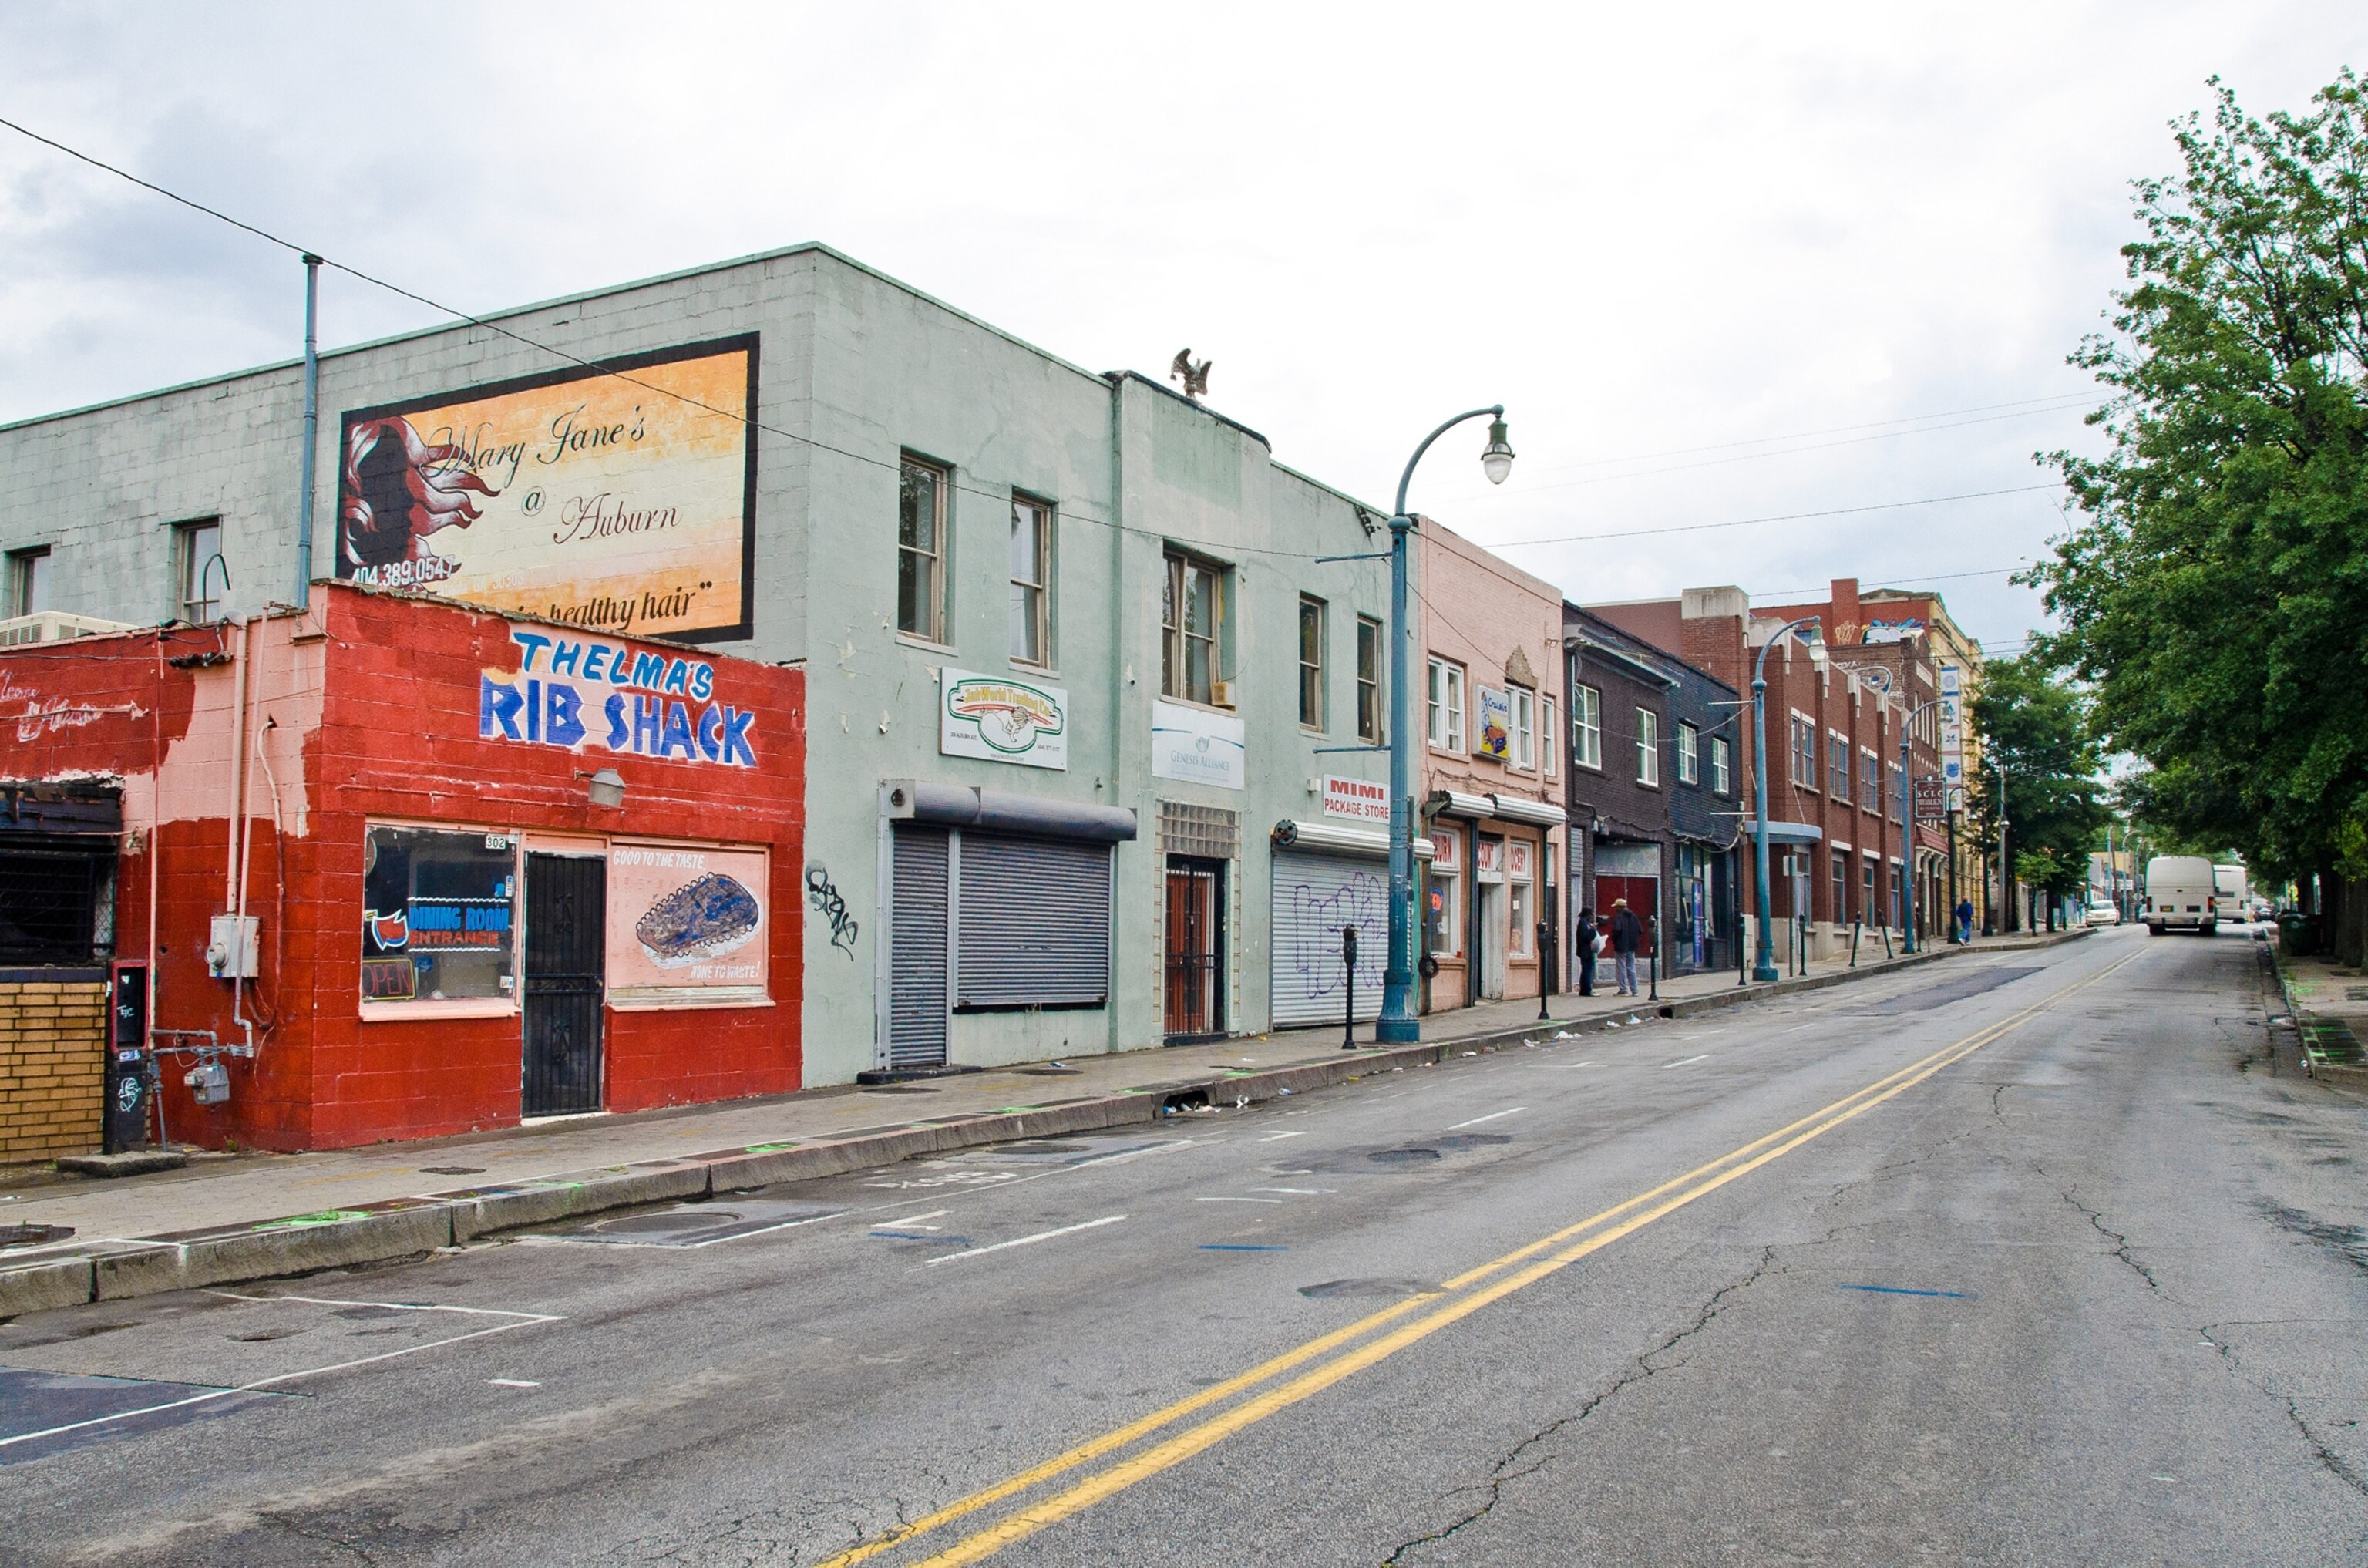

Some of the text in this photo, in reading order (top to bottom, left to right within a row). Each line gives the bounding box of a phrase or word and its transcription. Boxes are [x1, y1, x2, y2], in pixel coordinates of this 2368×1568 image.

[419, 404, 644, 489] Mary Jane's
[521, 486, 547, 517] @
[553, 493, 683, 544] Auburn
[352, 554, 456, 587] 404.389.0547
[513, 631, 714, 698] THELMA'S
[480, 675, 758, 767] RIB SHACK
[1330, 779, 1384, 800] MIMI
[1324, 798, 1389, 819] PACKAGE STORE
[487, 837, 506, 848] 302
[613, 850, 641, 866] GOOD
[642, 852, 655, 866] TO
[655, 853, 674, 868] THE
[409, 906, 510, 931] DINING ROOM
[409, 930, 500, 945] ENTRANCE
[362, 964, 412, 995] OPEN
[691, 964, 713, 979] NONE
[726, 961, 761, 980] WASTE!
